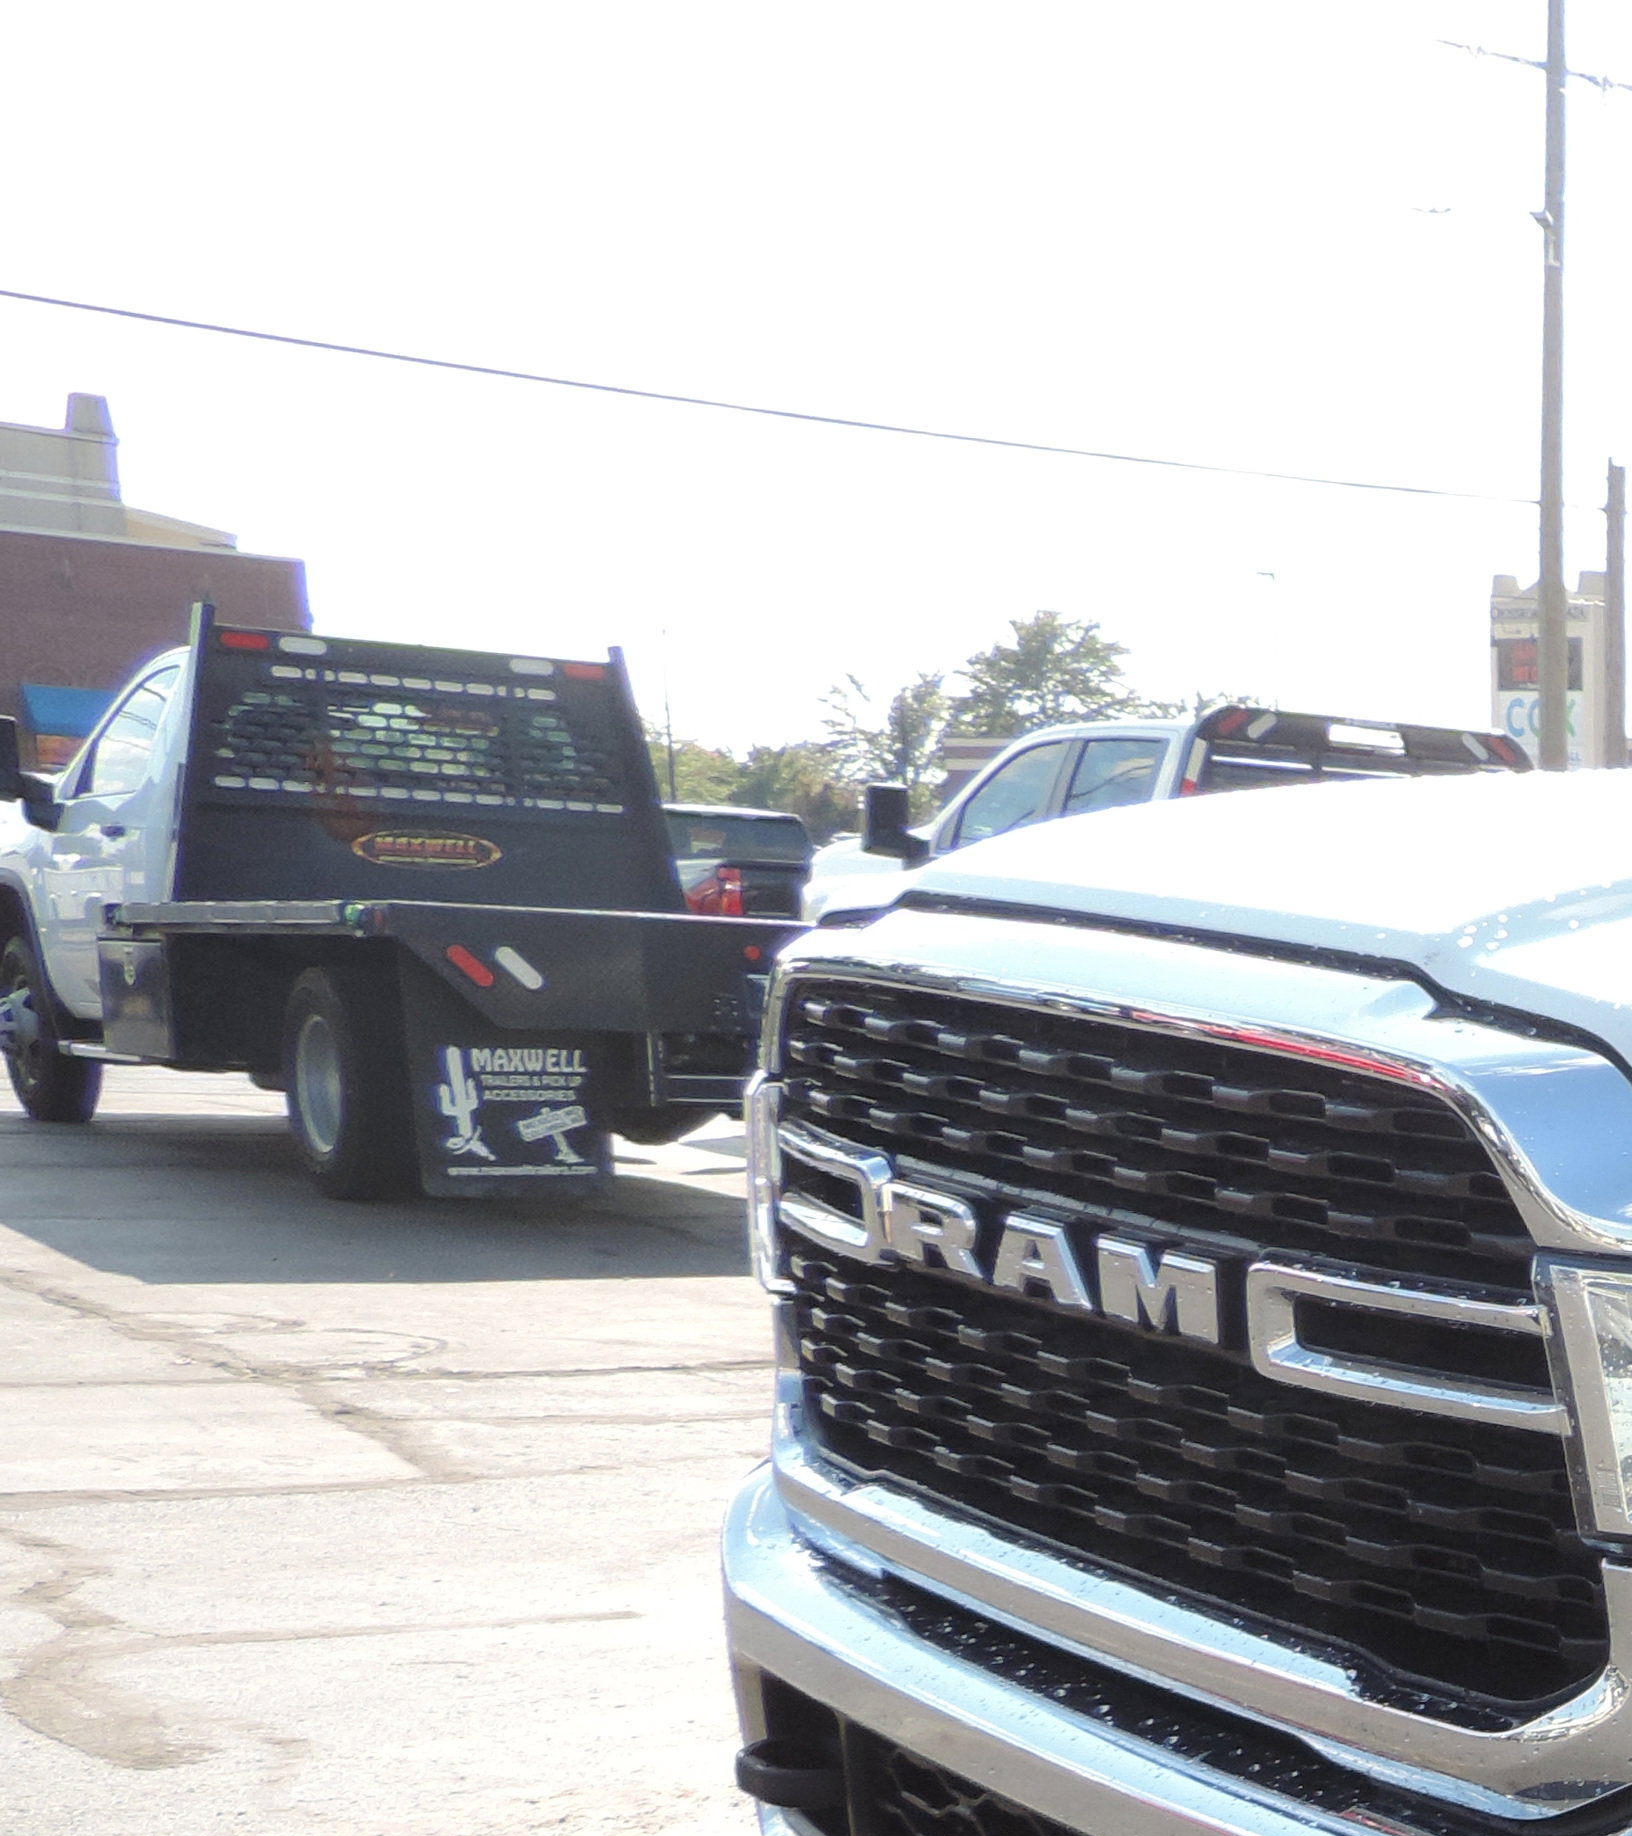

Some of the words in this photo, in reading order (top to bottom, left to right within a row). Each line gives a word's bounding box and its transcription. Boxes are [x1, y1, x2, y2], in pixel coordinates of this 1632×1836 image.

[374, 836, 478, 854] MAXWELL
[470, 1047, 587, 1073] MAXWELL
[483, 1089, 577, 1101] ACCESSORIES
[883, 1180, 1220, 1345] RAM
